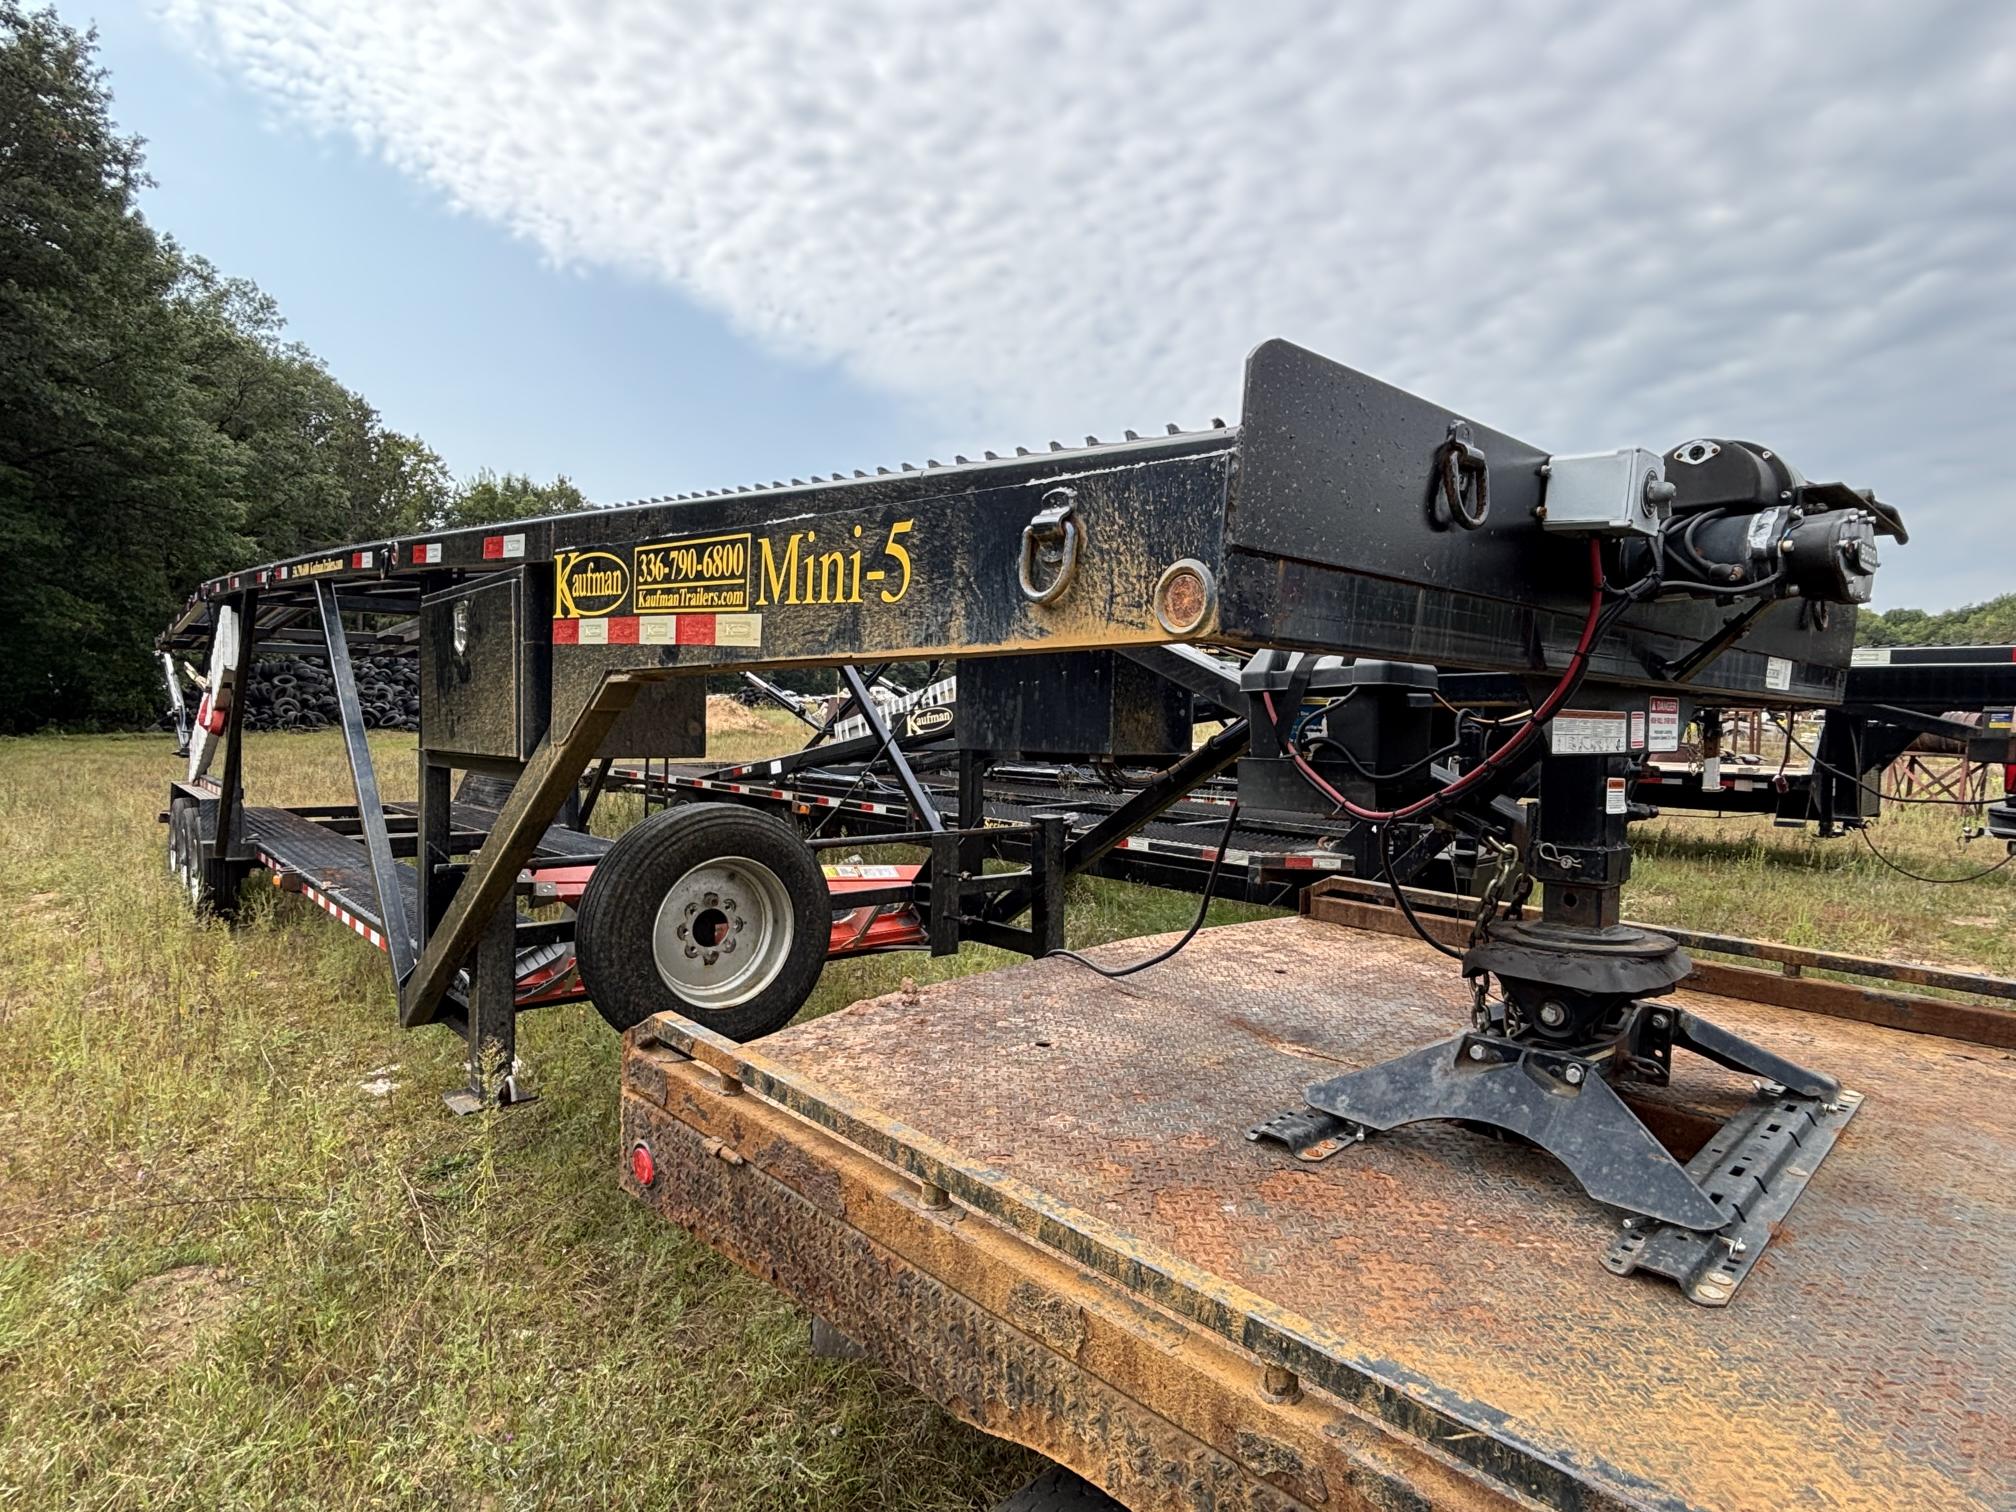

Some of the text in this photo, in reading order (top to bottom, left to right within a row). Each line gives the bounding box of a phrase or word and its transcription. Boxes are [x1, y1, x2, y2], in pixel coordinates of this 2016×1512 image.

[638, 542, 745, 583] 336-790-6800
[755, 518, 914, 606] Mini-5
[552, 551, 623, 619] Kaufman
[637, 587, 744, 608] KaufmanTrailers.com
[905, 708, 951, 737] Kaufman
